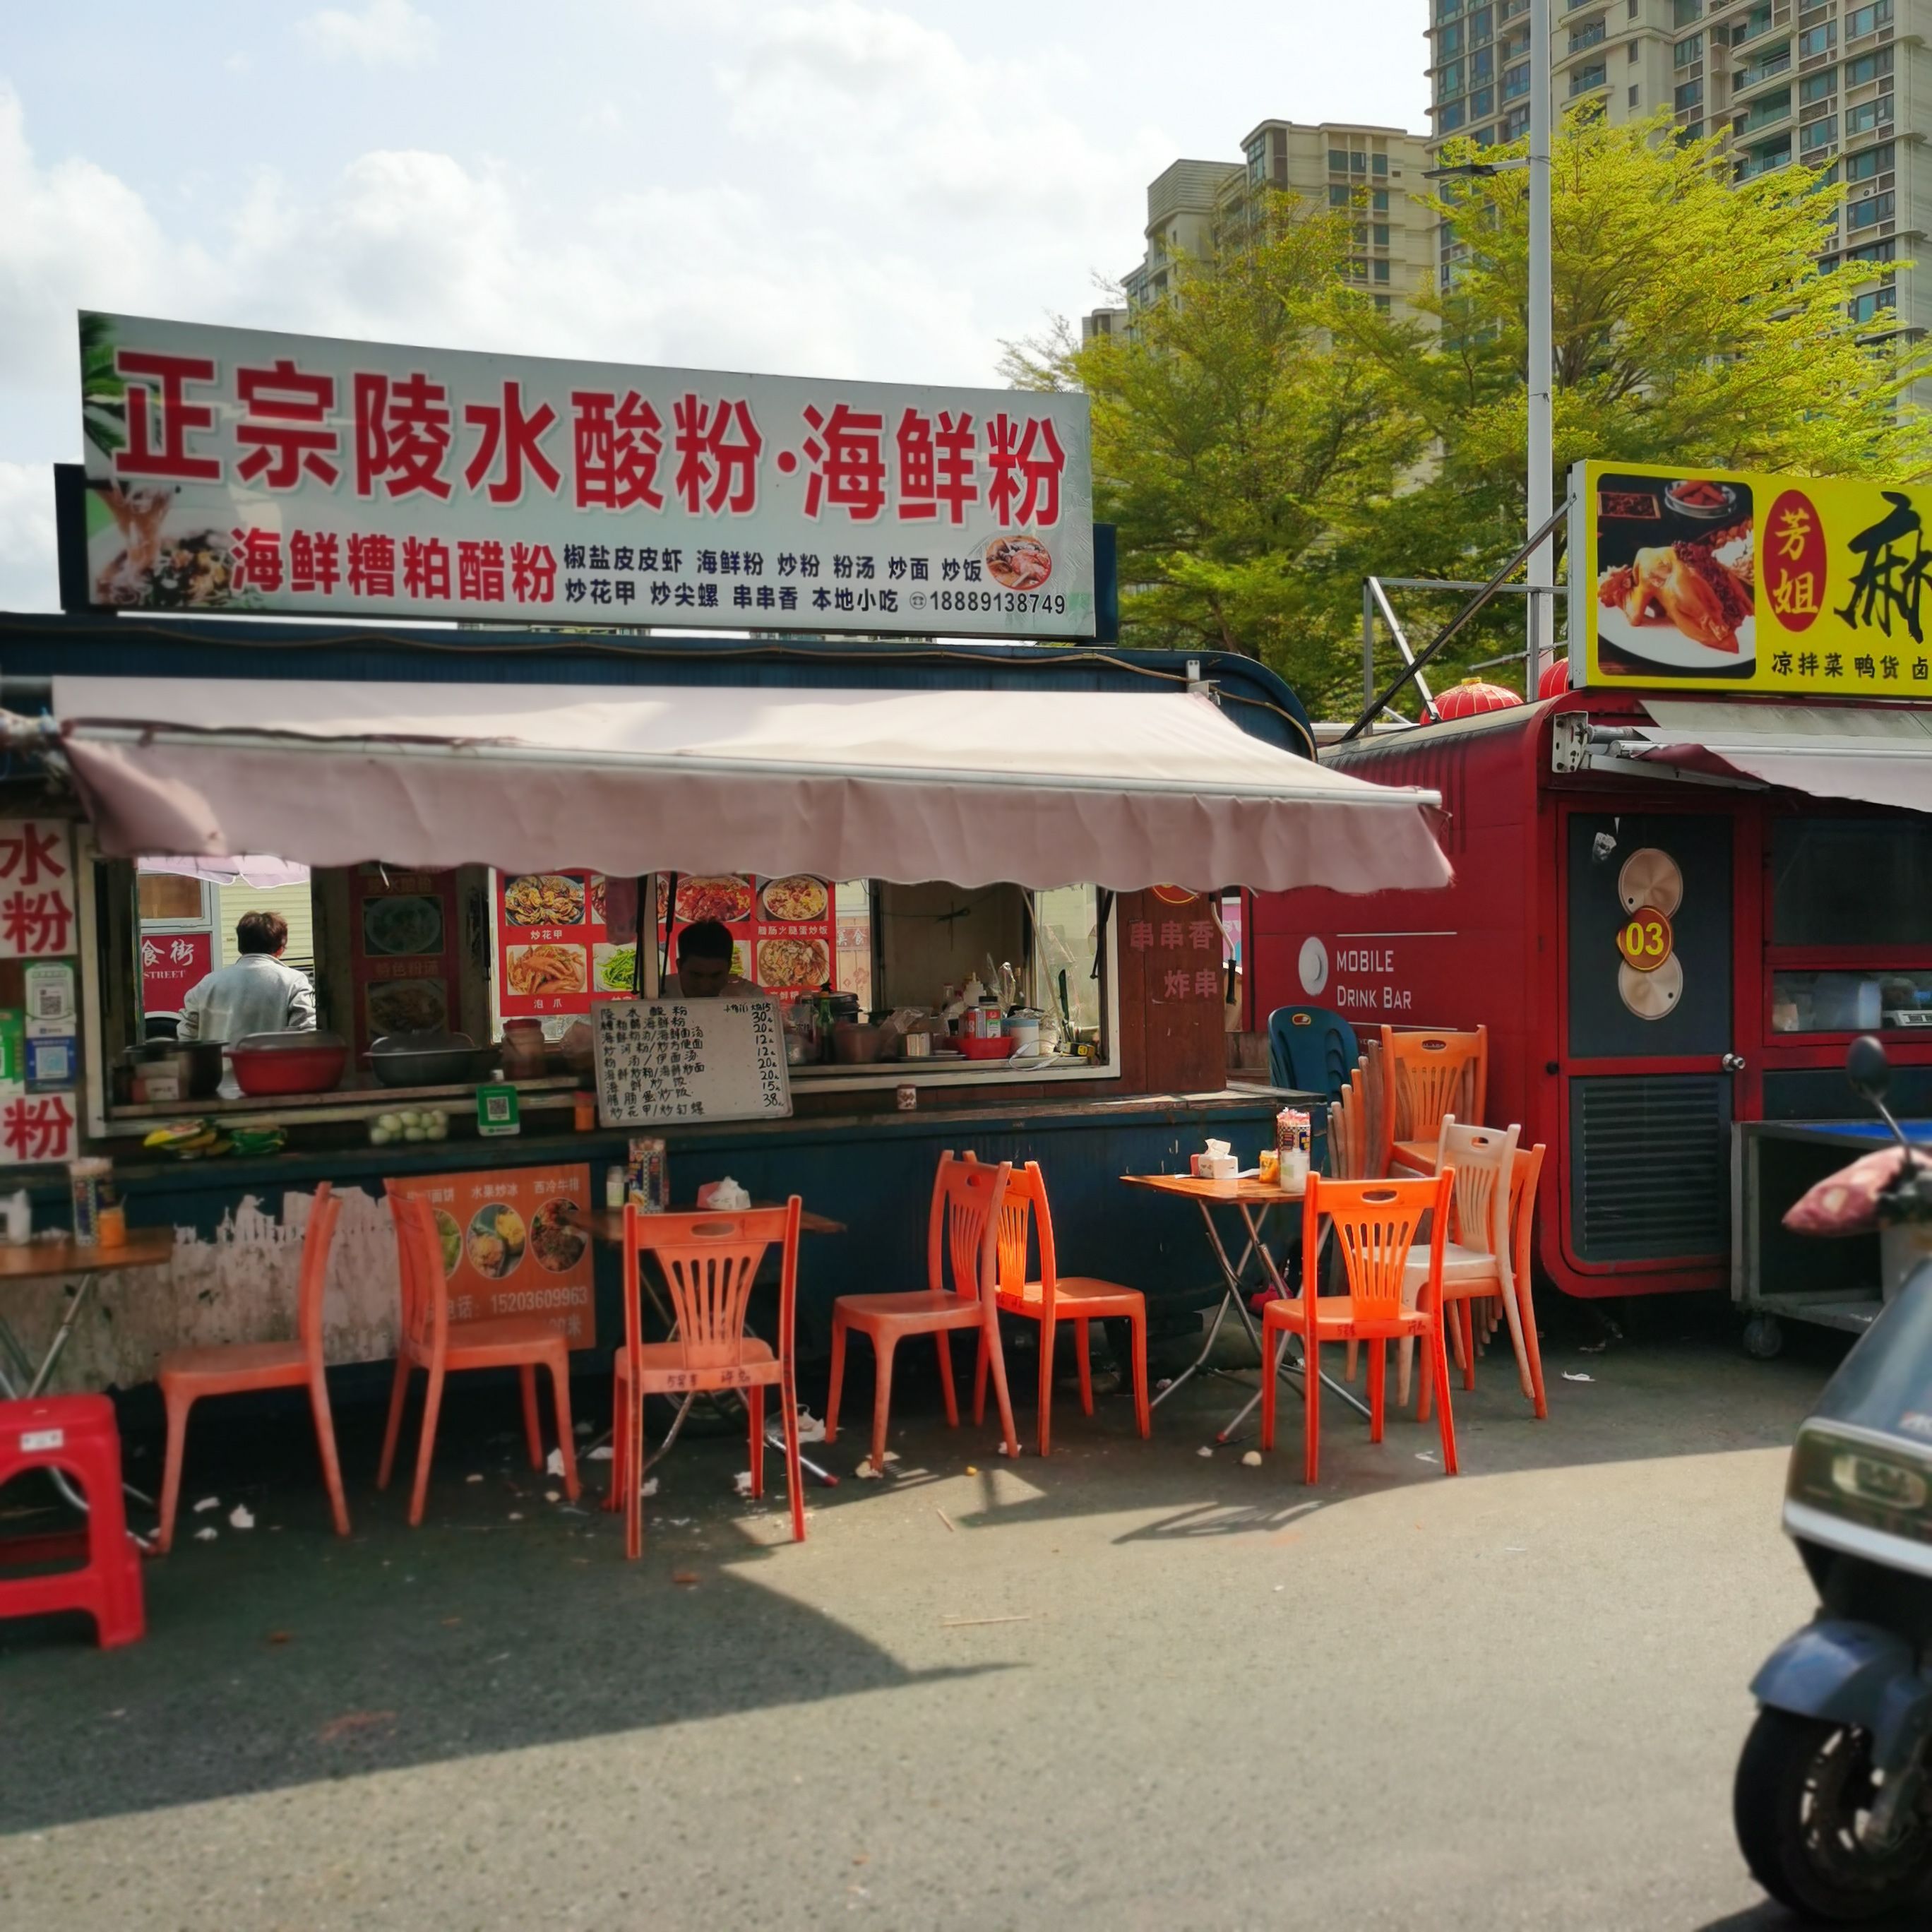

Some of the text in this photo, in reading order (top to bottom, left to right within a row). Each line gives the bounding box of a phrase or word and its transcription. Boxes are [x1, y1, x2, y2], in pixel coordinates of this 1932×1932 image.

[114, 349, 1066, 528] 正宗陵水酸粉·海鲜粉
[229, 527, 558, 603] 海鲜糟粕醋粉
[564, 544, 983, 583] 椒盐皮皮虾 海鲜粉 炒粉 粉汤 炒面 炒饭
[1773, 508, 1819, 616] 芳姐
[565, 578, 1066, 614] 炒花甲 炒尖螺 串串香 本地小吃 18889138749
[1771, 651, 1930, 680] 凉拌菜 鸭货 卤
[530, 929, 563, 941] 炒花甲
[1131, 920, 1214, 951] 串串香
[1626, 922, 1664, 955] 03
[1337, 950, 1395, 972] MOBILE
[1164, 968, 1218, 999] 炸串
[3, 1096, 73, 1160] 粉
[533, 1177, 580, 1194] 西冷牛排
[491, 1286, 588, 1315] 15203609963
